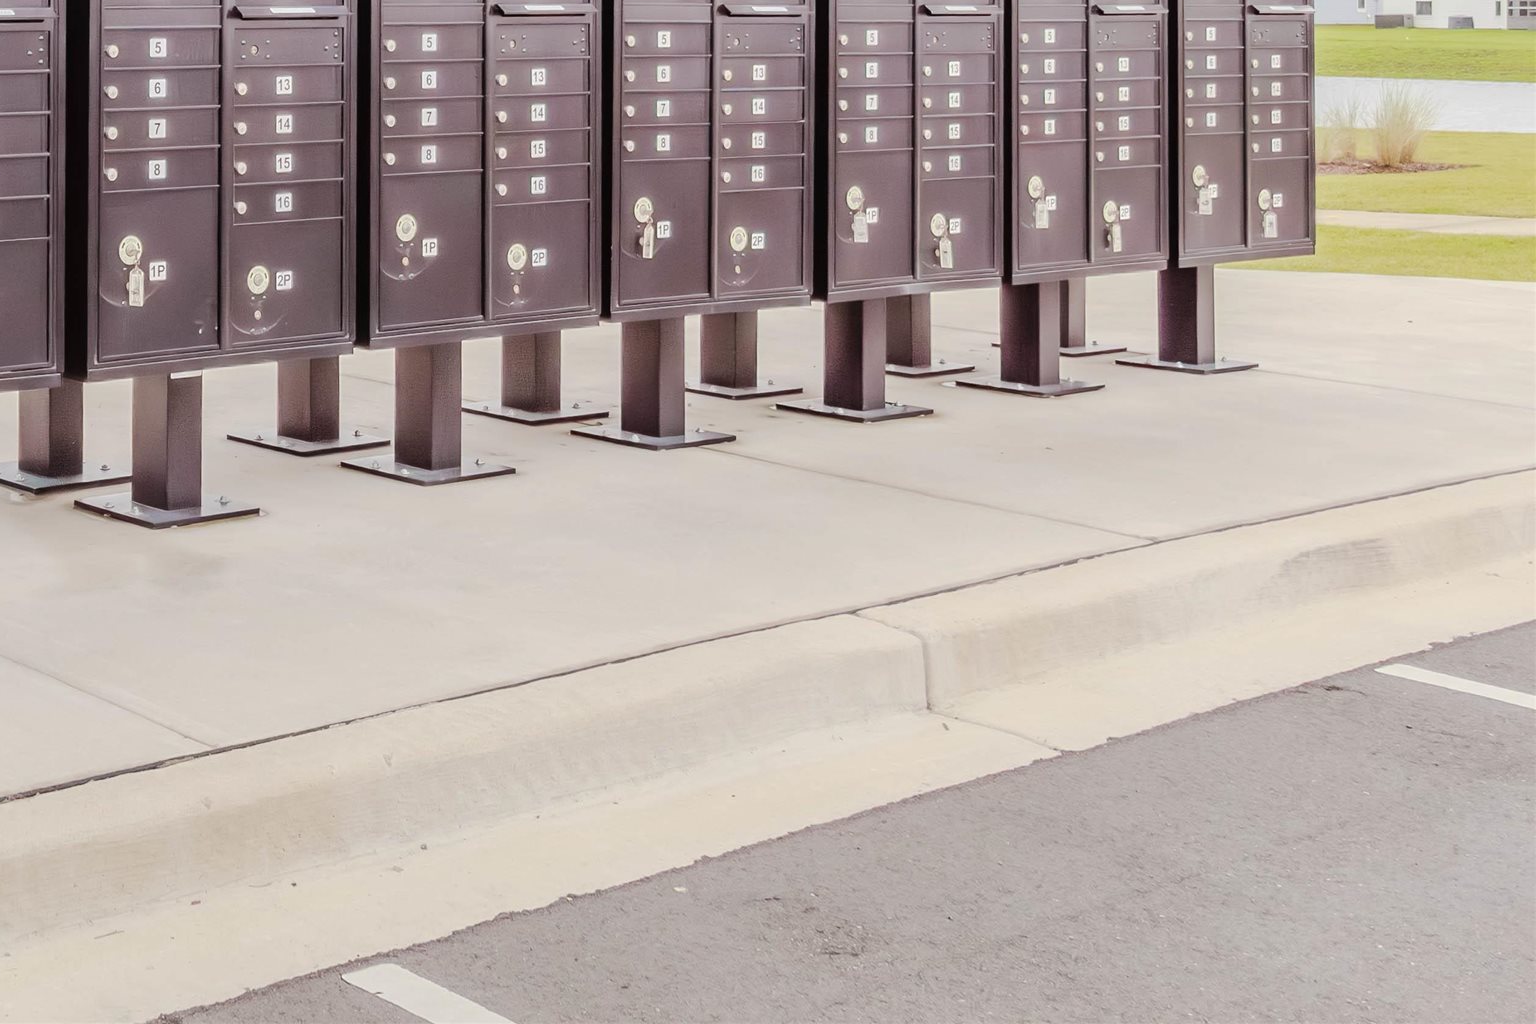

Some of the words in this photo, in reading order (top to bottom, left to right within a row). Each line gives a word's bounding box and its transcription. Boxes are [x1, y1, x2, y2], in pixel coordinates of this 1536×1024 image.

[426, 36, 433, 49] 5
[661, 33, 667, 46] 5
[154, 41, 162, 55] 5
[660, 67, 667, 80] 6
[754, 67, 764, 79] 13
[950, 63, 959, 74] 13
[425, 73, 433, 87] 6
[533, 70, 544, 83] 13
[154, 81, 161, 95] 6
[278, 78, 291, 92] 13
[754, 101, 764, 112] 14
[950, 95, 959, 105] 14
[533, 107, 544, 119] 14
[660, 103, 666, 114] 7
[426, 111, 432, 123] 7
[154, 122, 161, 135] 7
[277, 117, 291, 131] 14
[950, 126, 959, 137] 15
[660, 137, 667, 149] 8
[753, 135, 763, 146] 15
[425, 148, 432, 161] 8
[532, 142, 544, 155] 15
[153, 163, 161, 176] 8
[277, 156, 290, 170] 15
[950, 158, 959, 169] 16
[753, 168, 763, 179] 16
[533, 179, 544, 191] 16
[277, 195, 290, 209] 16
[866, 209, 877, 221] 1P
[658, 224, 670, 236] 1P
[949, 221, 960, 232] 2P
[424, 241, 436, 254] 1P
[751, 235, 763, 247] 2P
[533, 251, 545, 264] 2P
[151, 264, 165, 278] 1P
[278, 273, 291, 287] 2P
